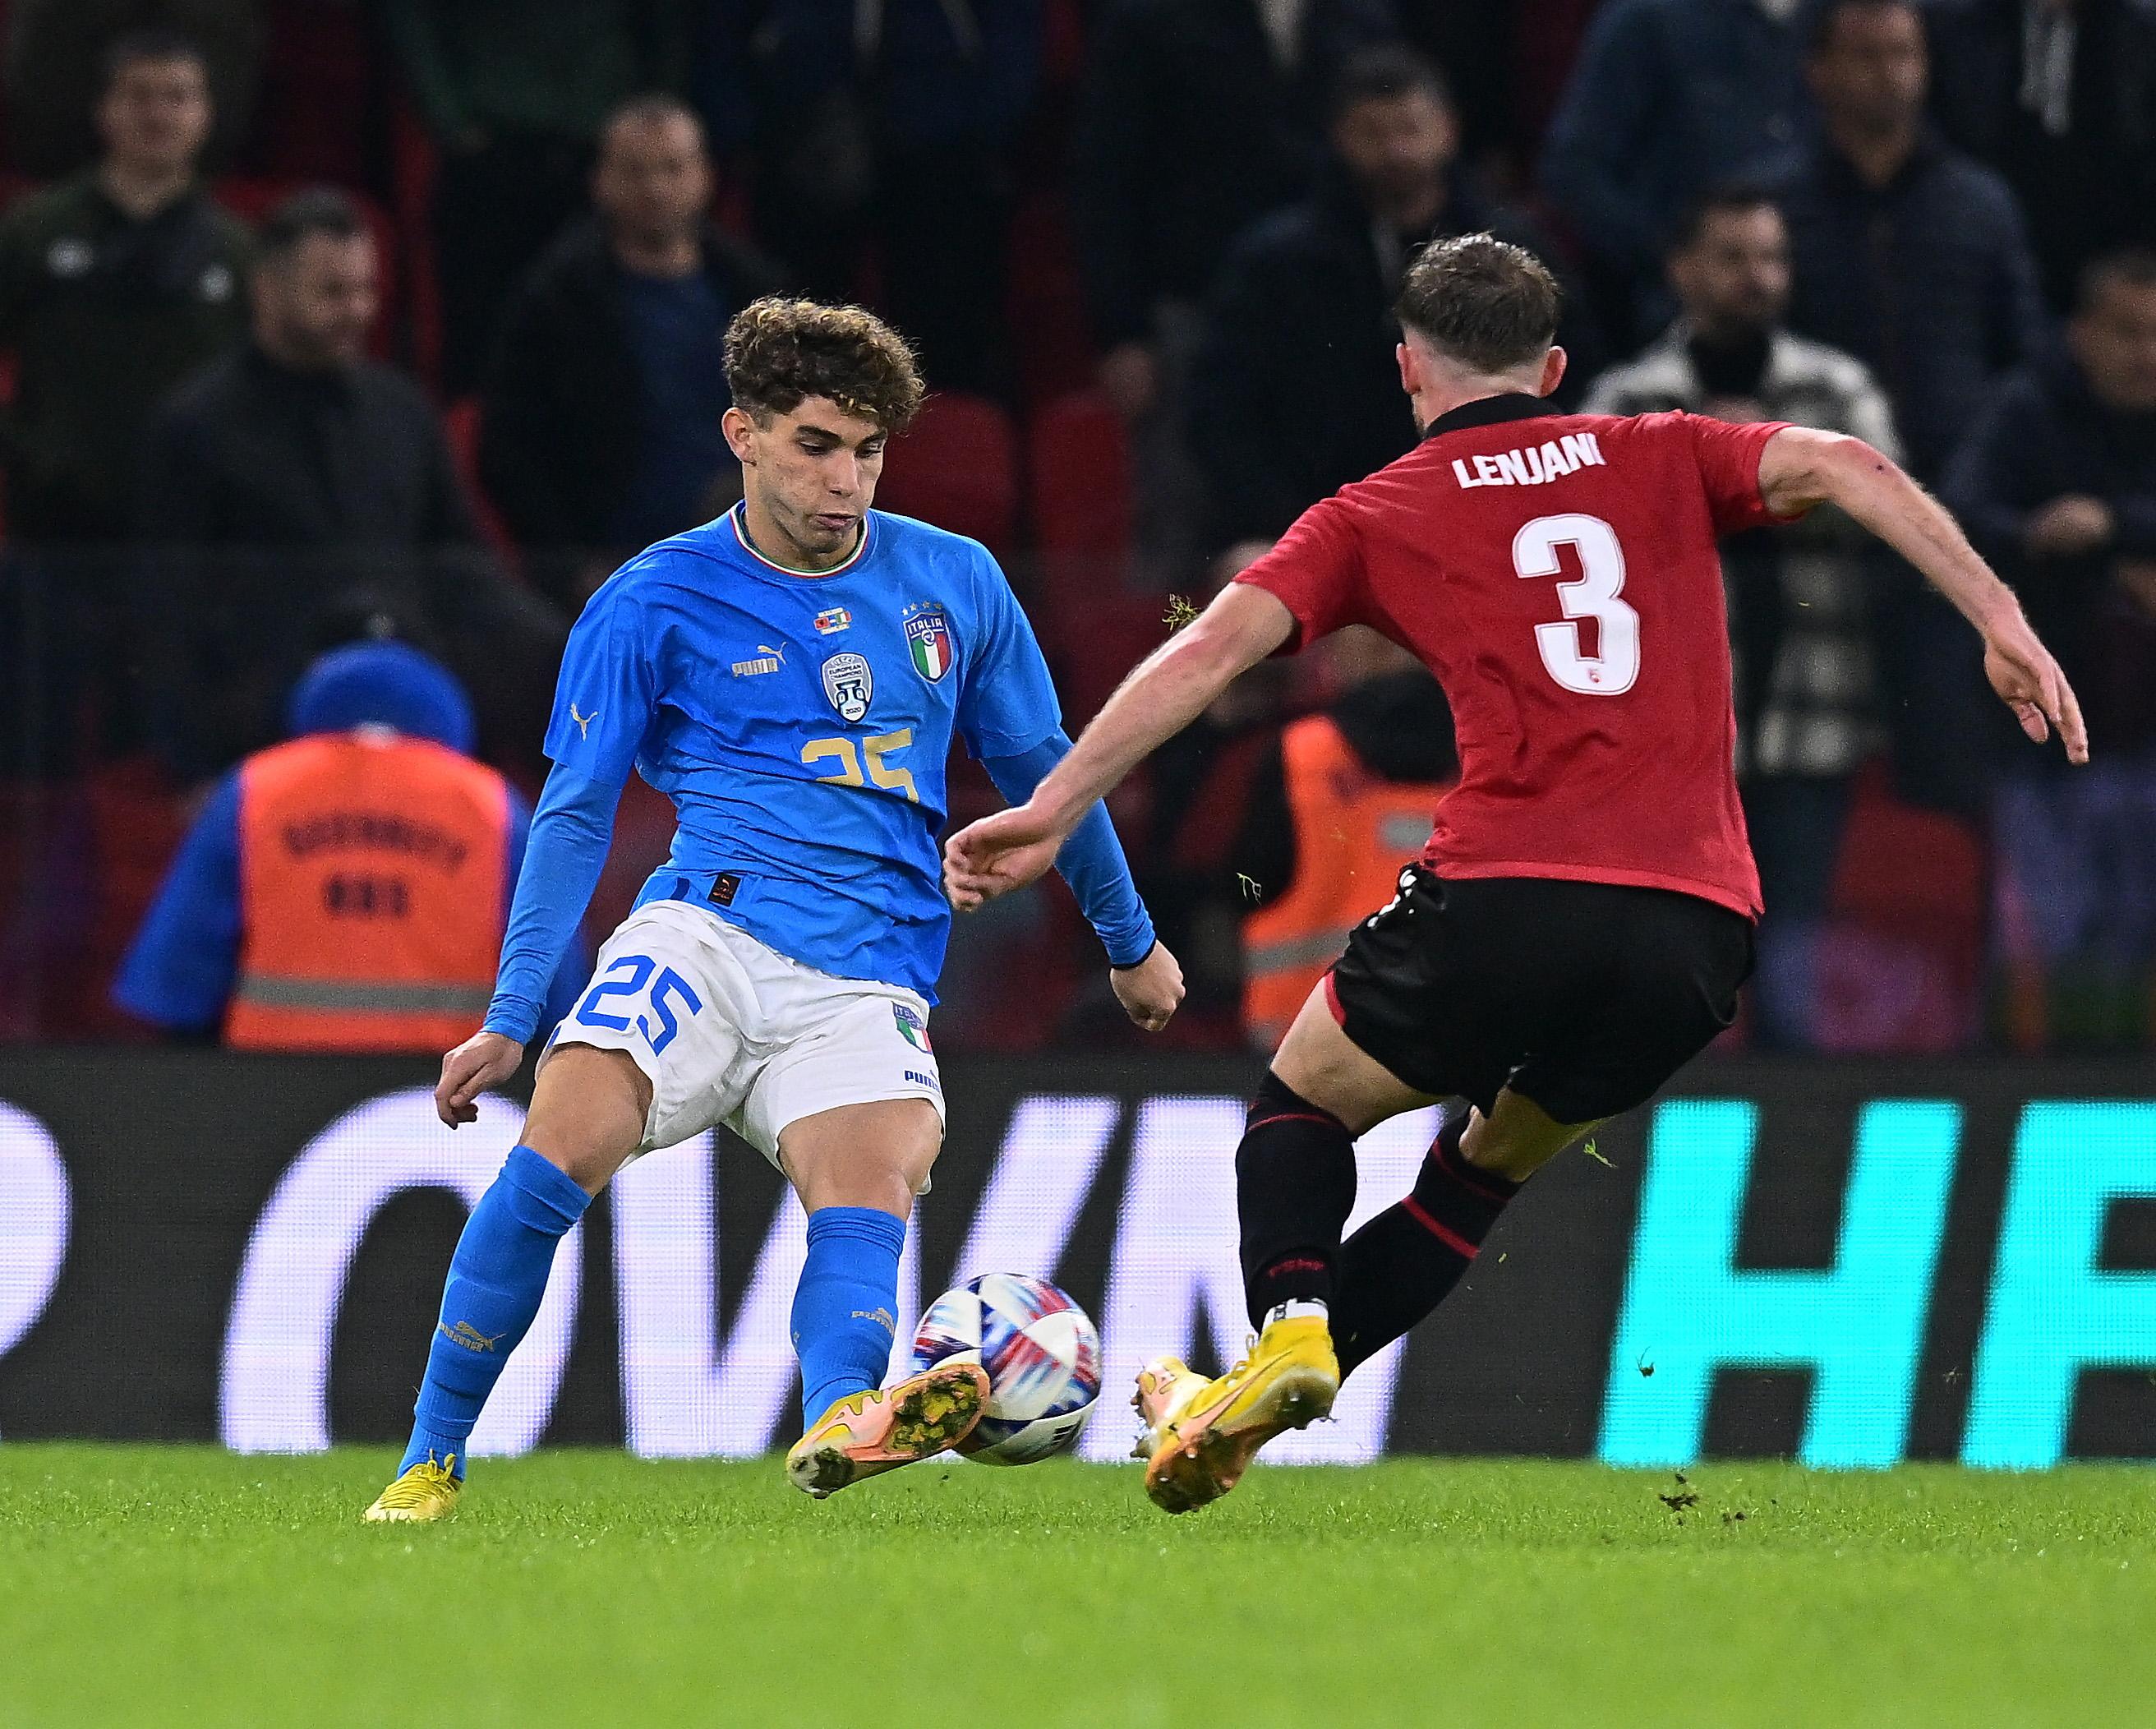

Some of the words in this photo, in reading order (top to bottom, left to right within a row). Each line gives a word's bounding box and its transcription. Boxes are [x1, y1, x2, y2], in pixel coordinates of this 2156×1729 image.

[1451, 432, 1607, 489] LENJANI
[1512, 513, 1641, 696] 3
[907, 617, 943, 634] ITALIA
[829, 665, 861, 675] EUROPEAN
[830, 670, 862, 680] CHAMPIONS
[845, 706, 862, 715] 2020
[575, 955, 703, 1058] 25
